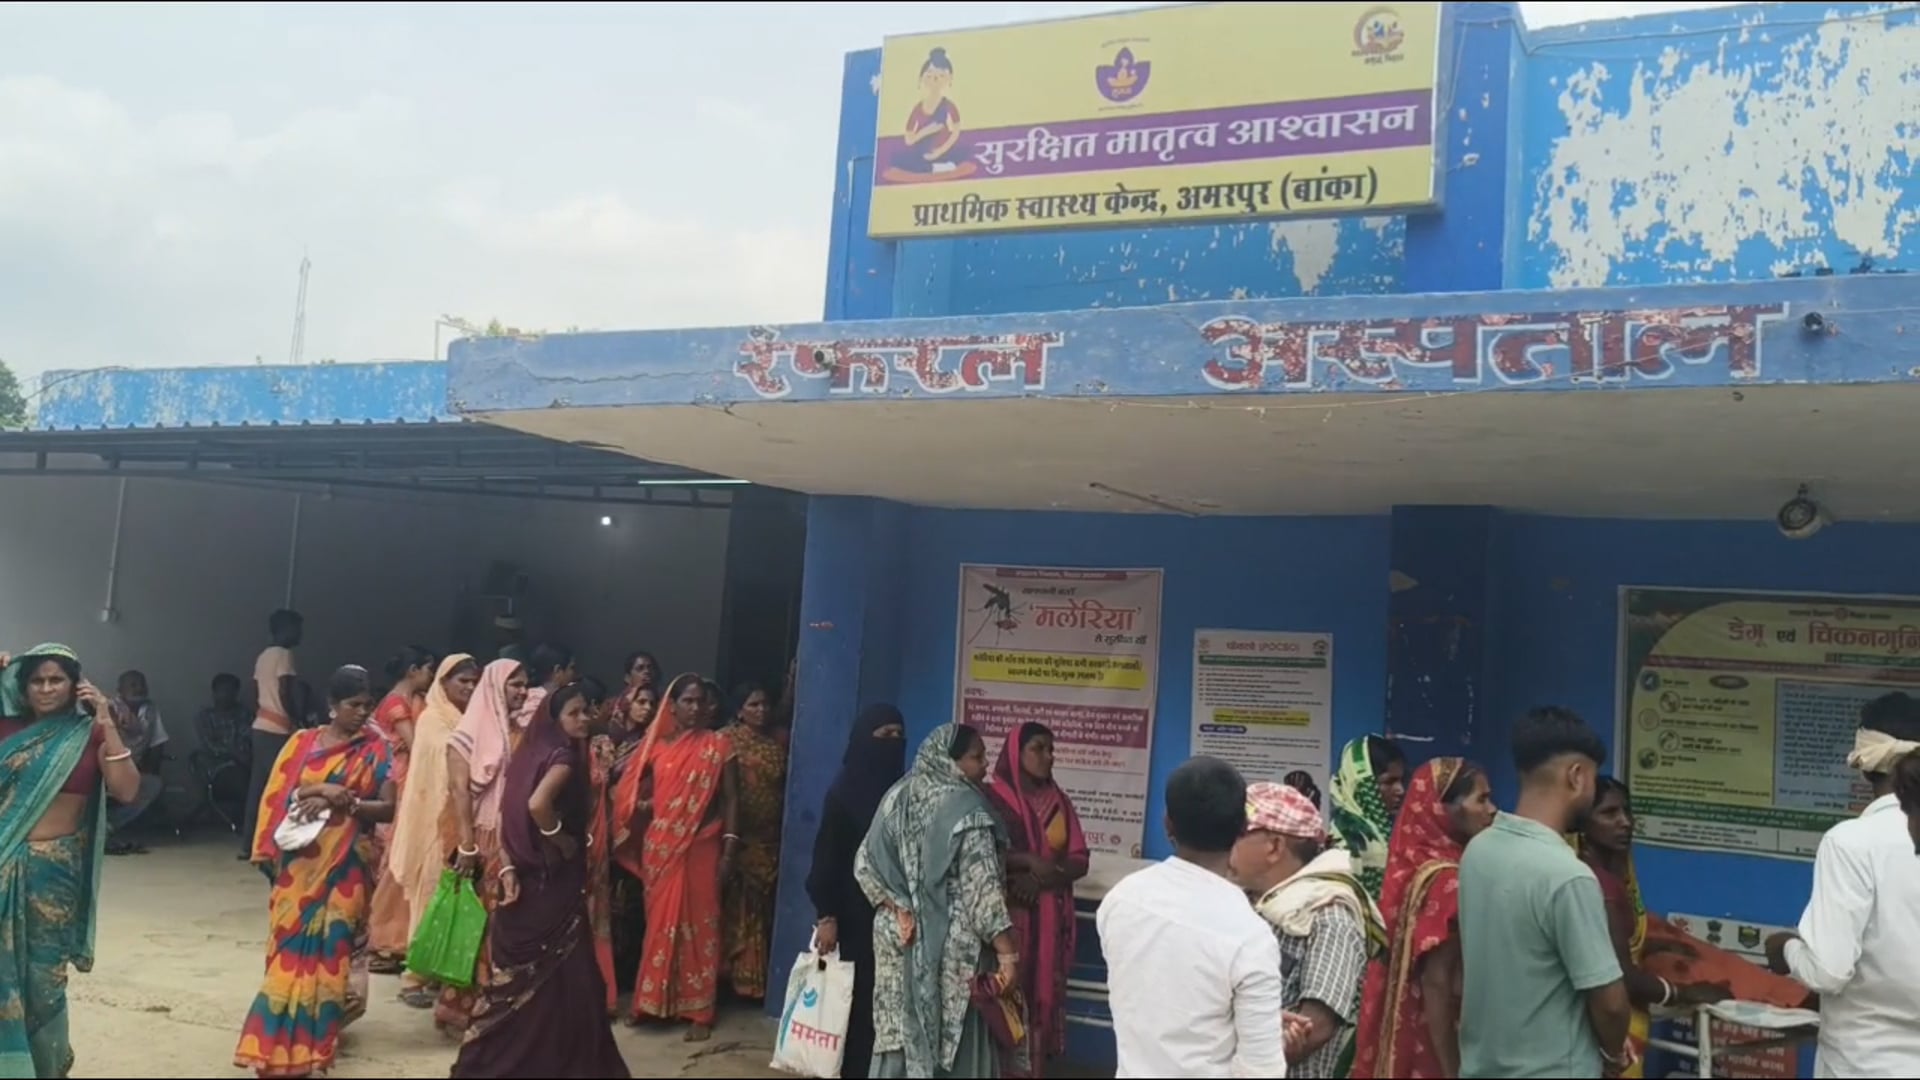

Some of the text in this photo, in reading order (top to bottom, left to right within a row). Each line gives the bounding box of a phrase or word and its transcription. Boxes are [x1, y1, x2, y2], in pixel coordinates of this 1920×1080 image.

[974, 104, 1419, 174] सुरक्षित मातृत्व आश्वासन
[912, 165, 1378, 227] प्राथमिक स्वास्थ्य केन्द्र, अमरपुर (बांका)
[1200, 301, 1787, 391] अस्पताल
[790, 1019, 842, 1051] ममता
